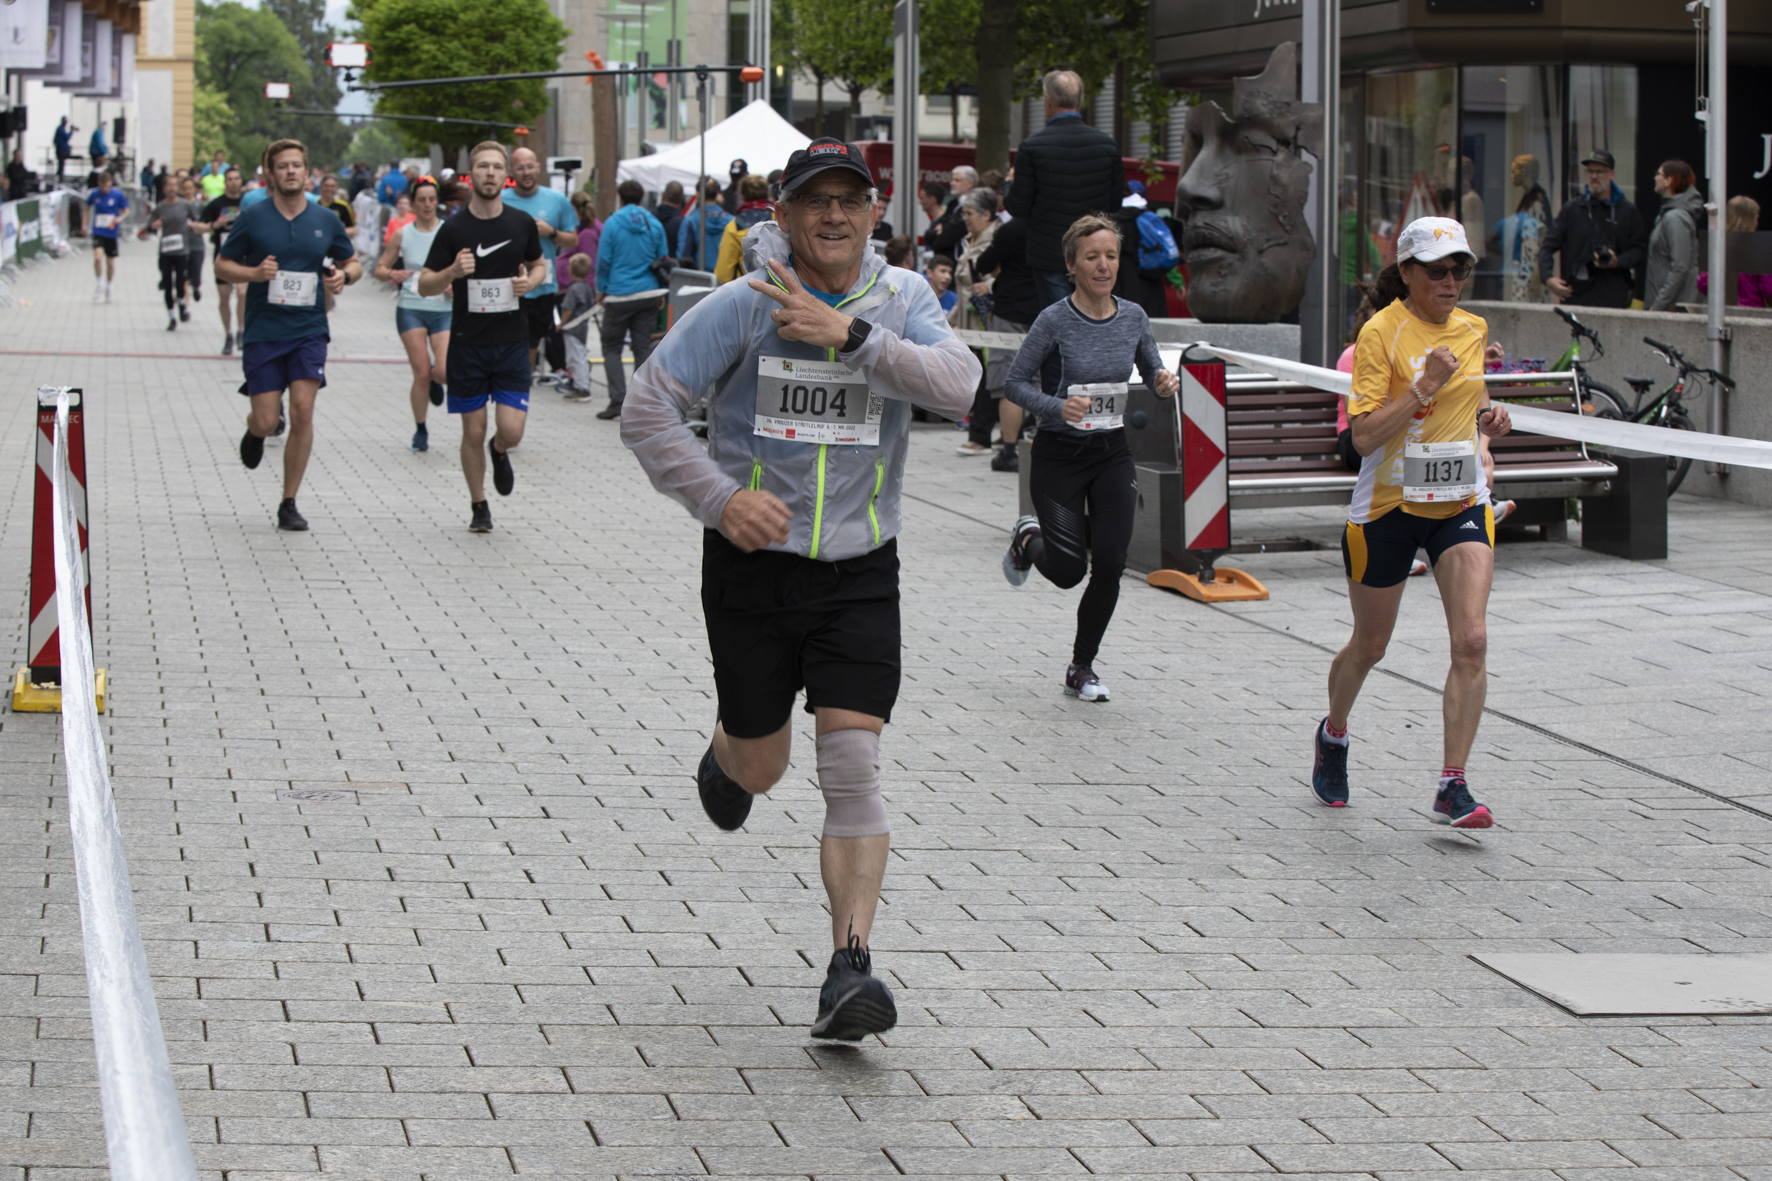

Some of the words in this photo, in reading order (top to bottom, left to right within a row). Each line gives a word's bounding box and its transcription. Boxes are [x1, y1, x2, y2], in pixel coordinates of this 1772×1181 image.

[283, 279, 302, 291] 823
[481, 287, 500, 298] 863
[795, 366, 854, 377] Liechtensteinische
[795, 373, 833, 381] Landesbank
[779, 383, 847, 418] 1004
[763, 426, 784, 435] MIGROS
[1424, 459, 1463, 483] 1137
